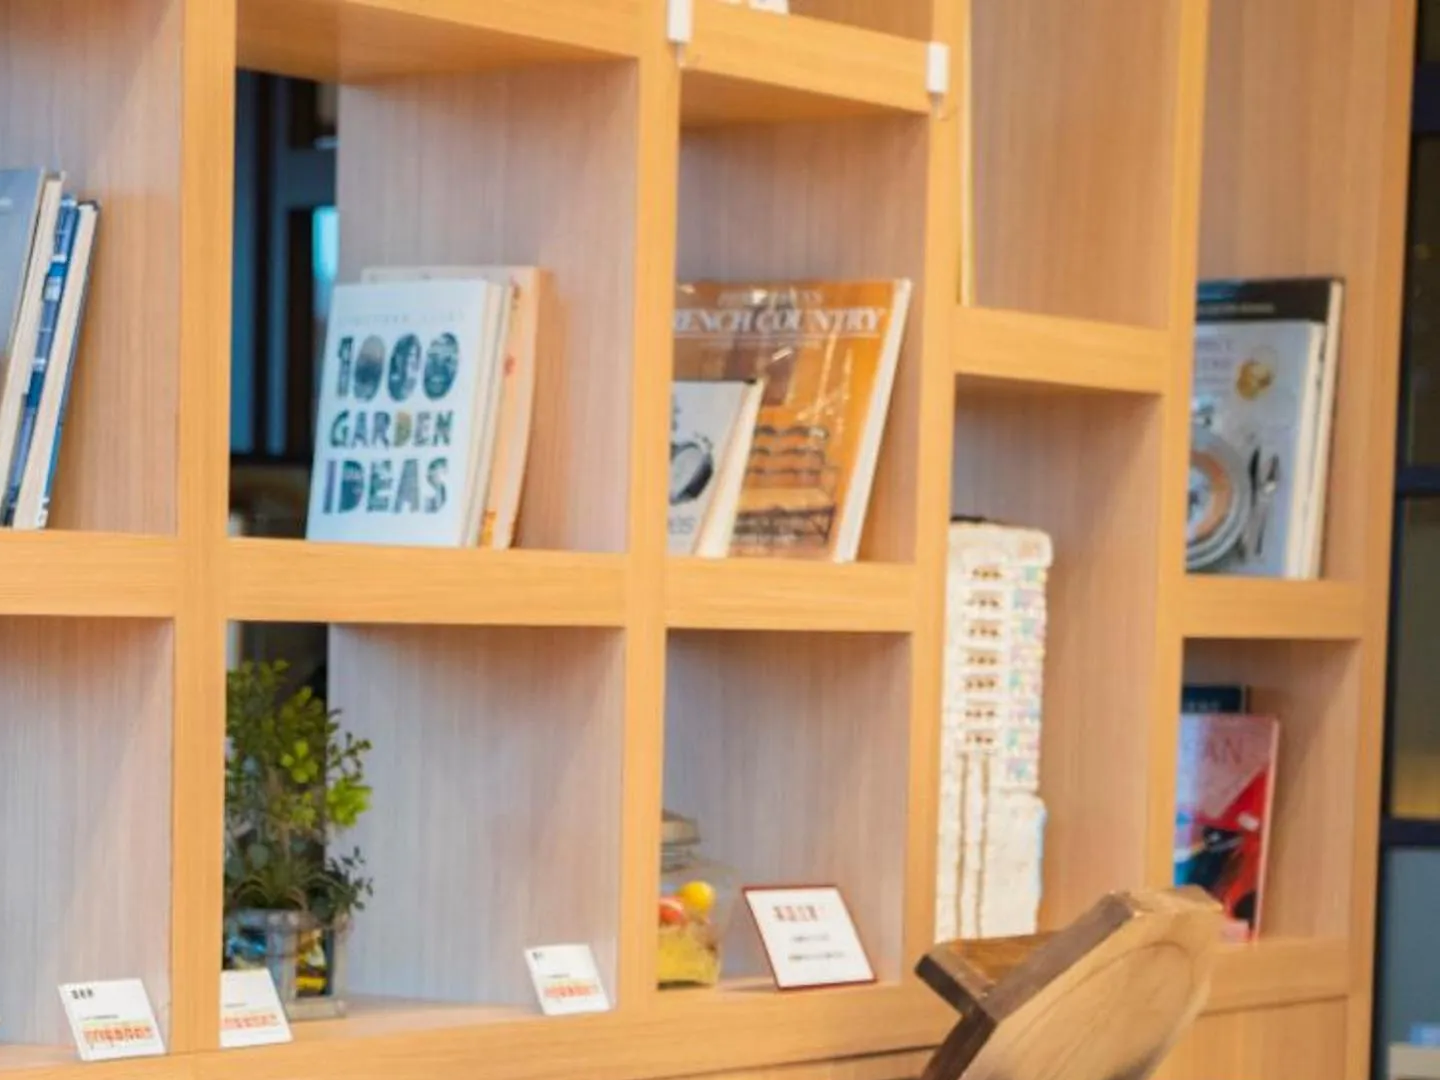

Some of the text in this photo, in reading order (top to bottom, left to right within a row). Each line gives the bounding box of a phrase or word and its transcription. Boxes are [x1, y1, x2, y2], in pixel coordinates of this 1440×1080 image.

[336, 332, 460, 402] 1000
[329, 409, 455, 449] GARDEN
[321, 457, 449, 514] IDEAS
